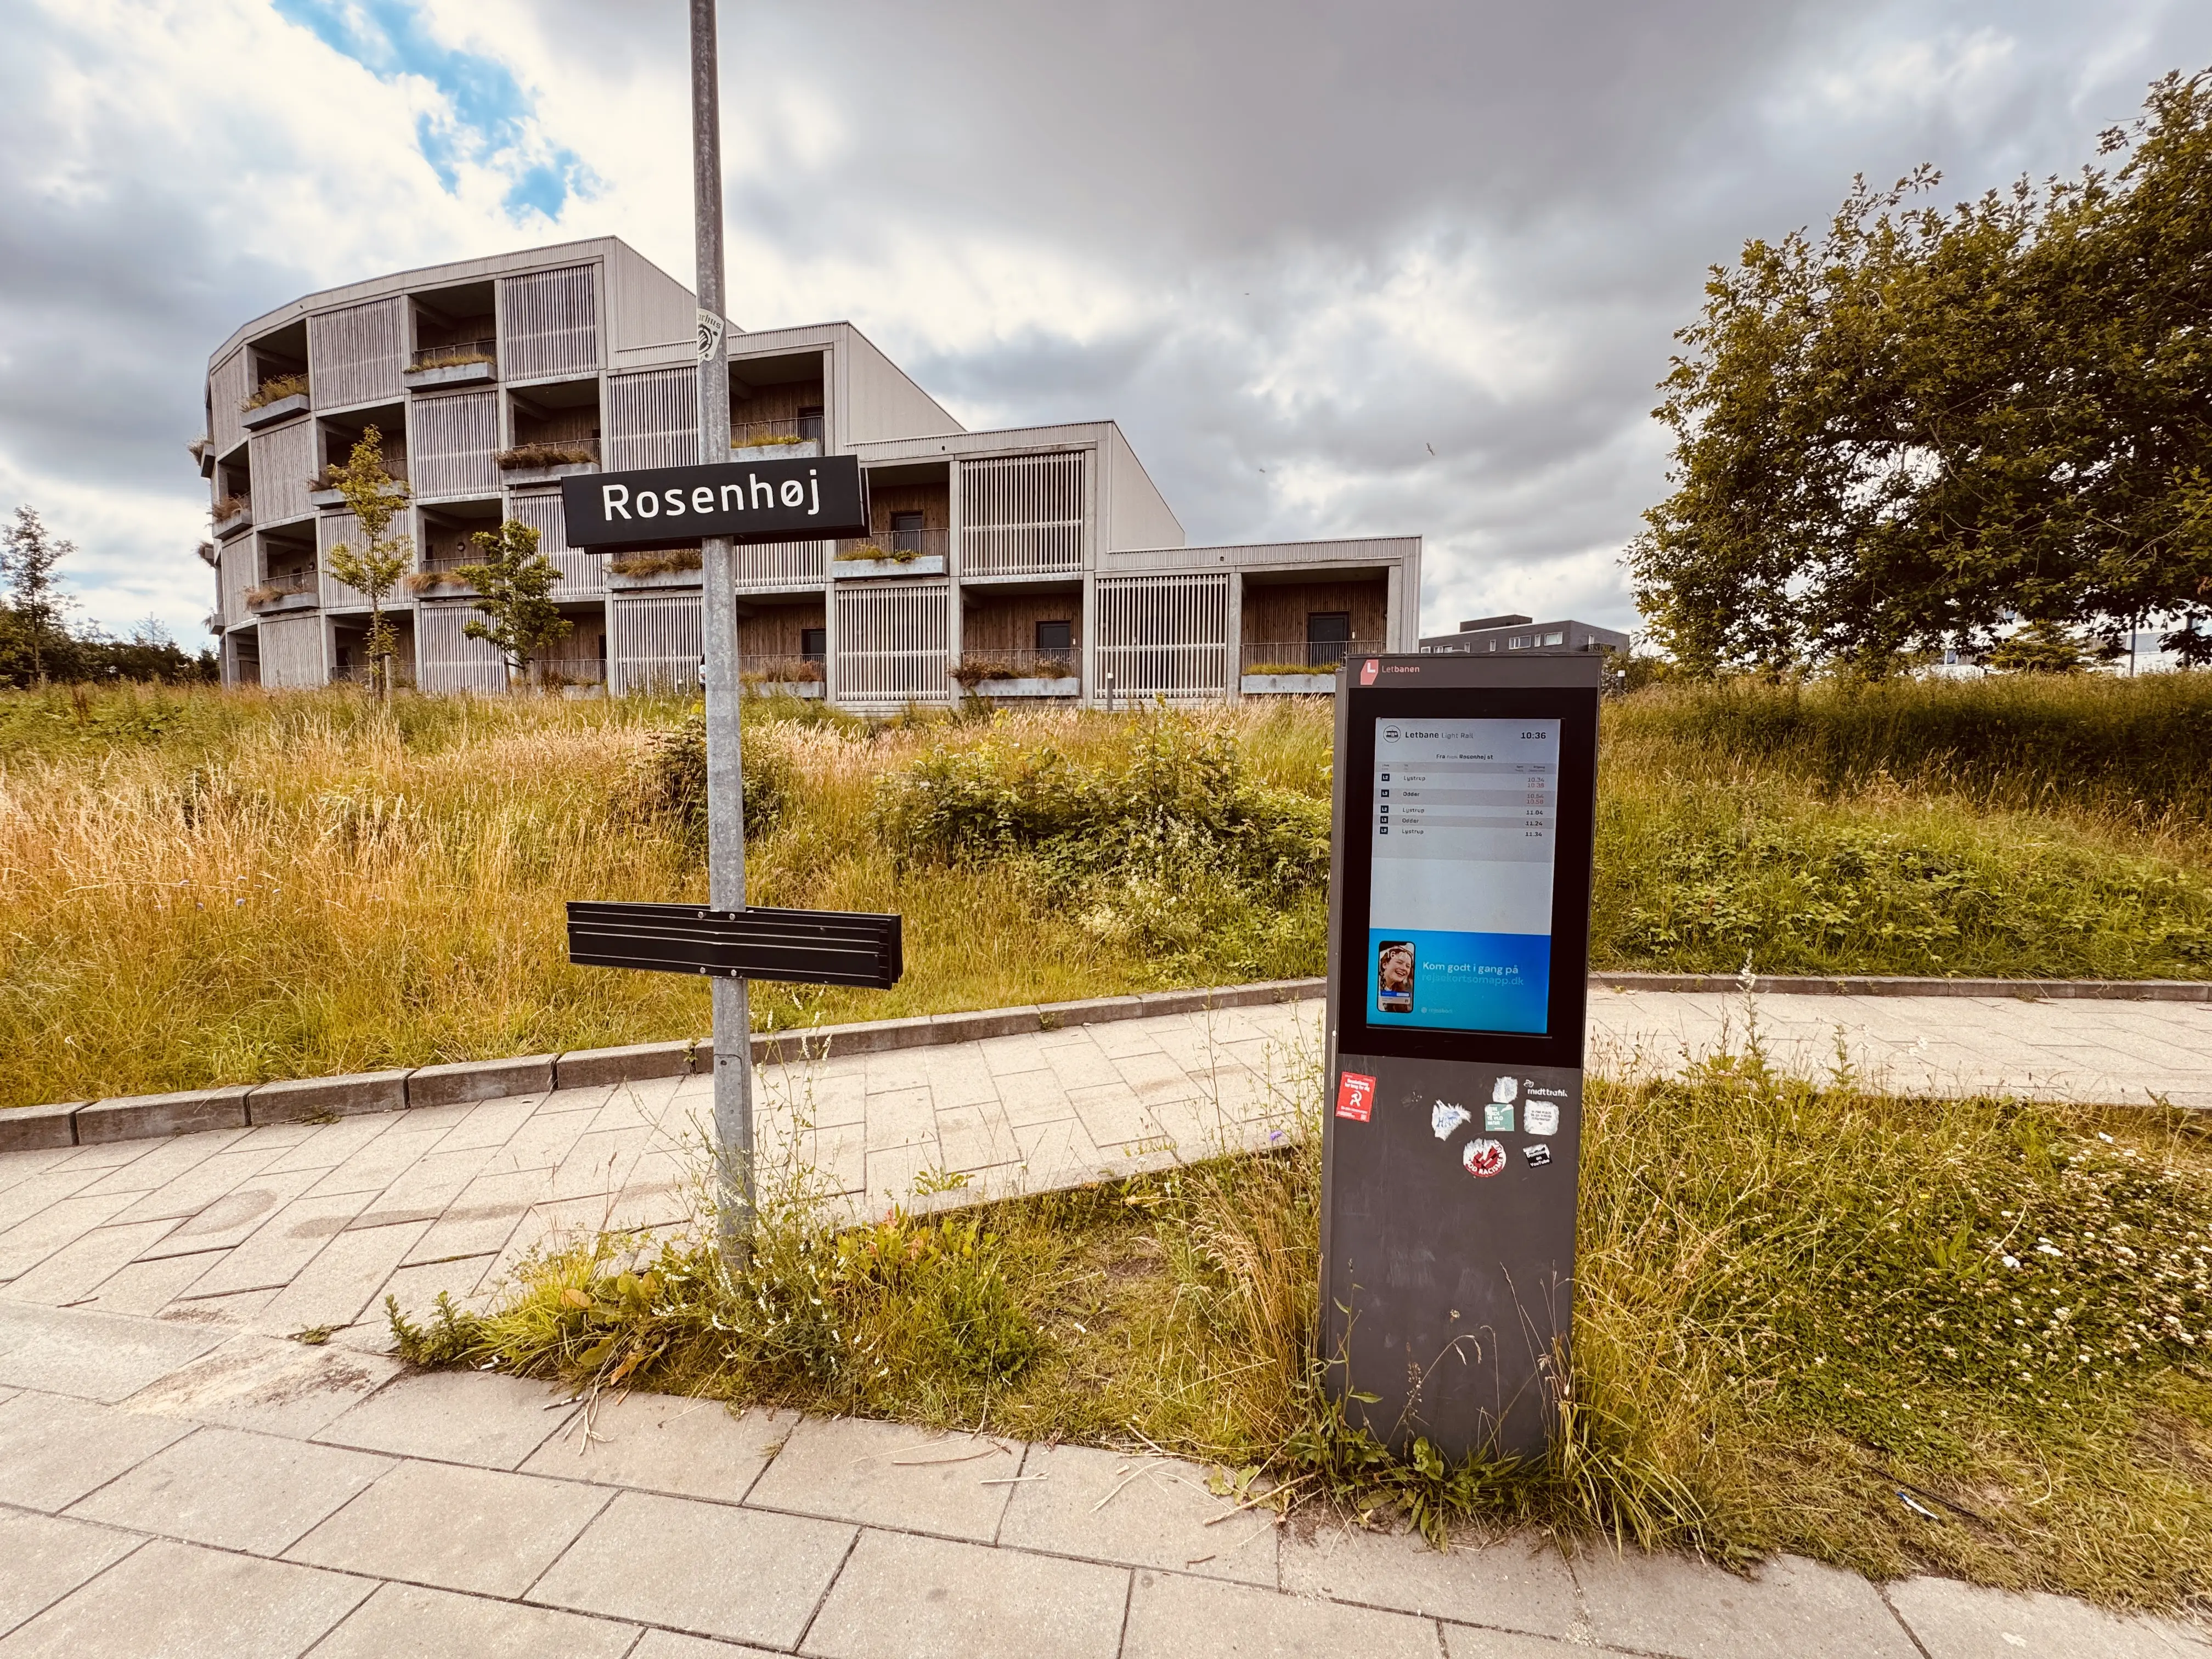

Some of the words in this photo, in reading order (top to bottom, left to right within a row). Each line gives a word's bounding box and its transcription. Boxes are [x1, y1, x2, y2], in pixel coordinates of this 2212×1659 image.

[698, 314, 721, 329] arhus
[603, 469, 820, 521] Rosenhøj
[1423, 962, 1445, 970] Kom
[1447, 963, 1470, 973] godt
[1473, 963, 1476, 972] i
[1478, 965, 1503, 975] gang
[1505, 964, 1519, 976] på
